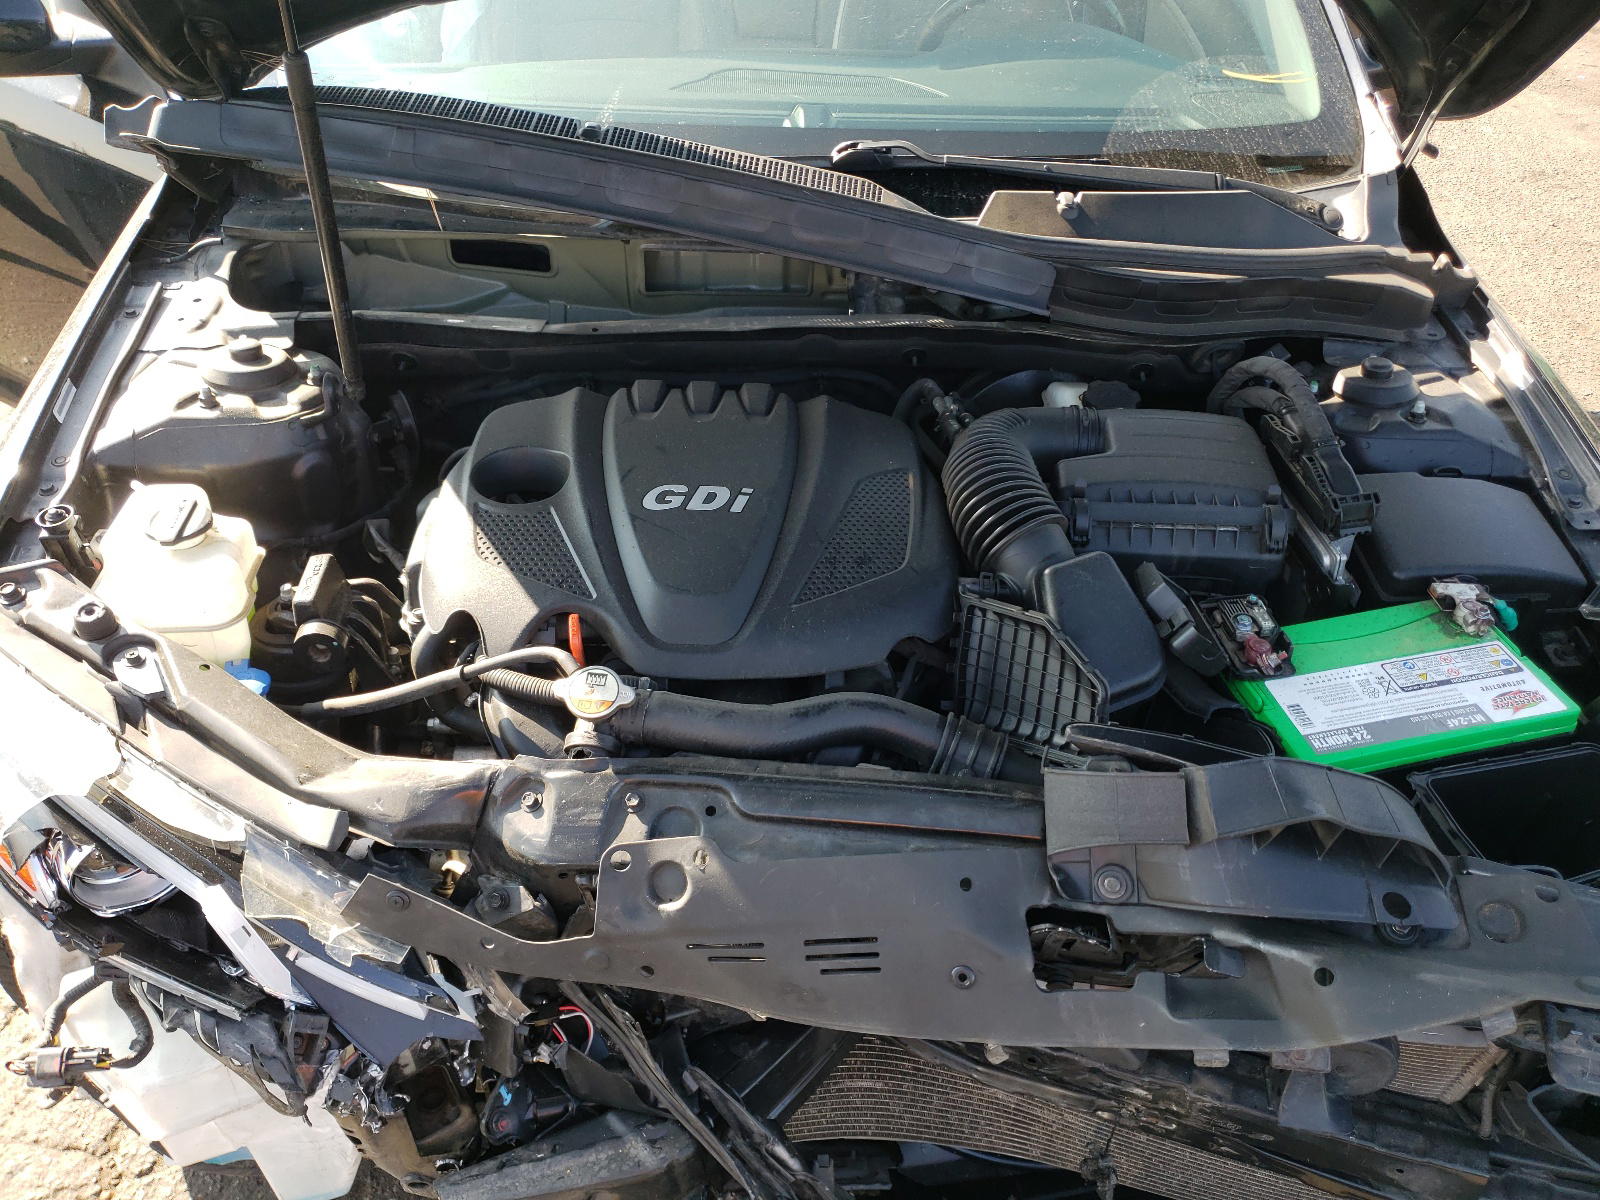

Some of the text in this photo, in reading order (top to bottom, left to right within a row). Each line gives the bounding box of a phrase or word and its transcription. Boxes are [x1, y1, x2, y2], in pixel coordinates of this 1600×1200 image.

[642, 484, 754, 513] GDi
[1479, 679, 1526, 692] AUTOMOTIVE
[1446, 714, 1486, 728] MT-24F
[1311, 730, 1371, 749] 24-MONTH
